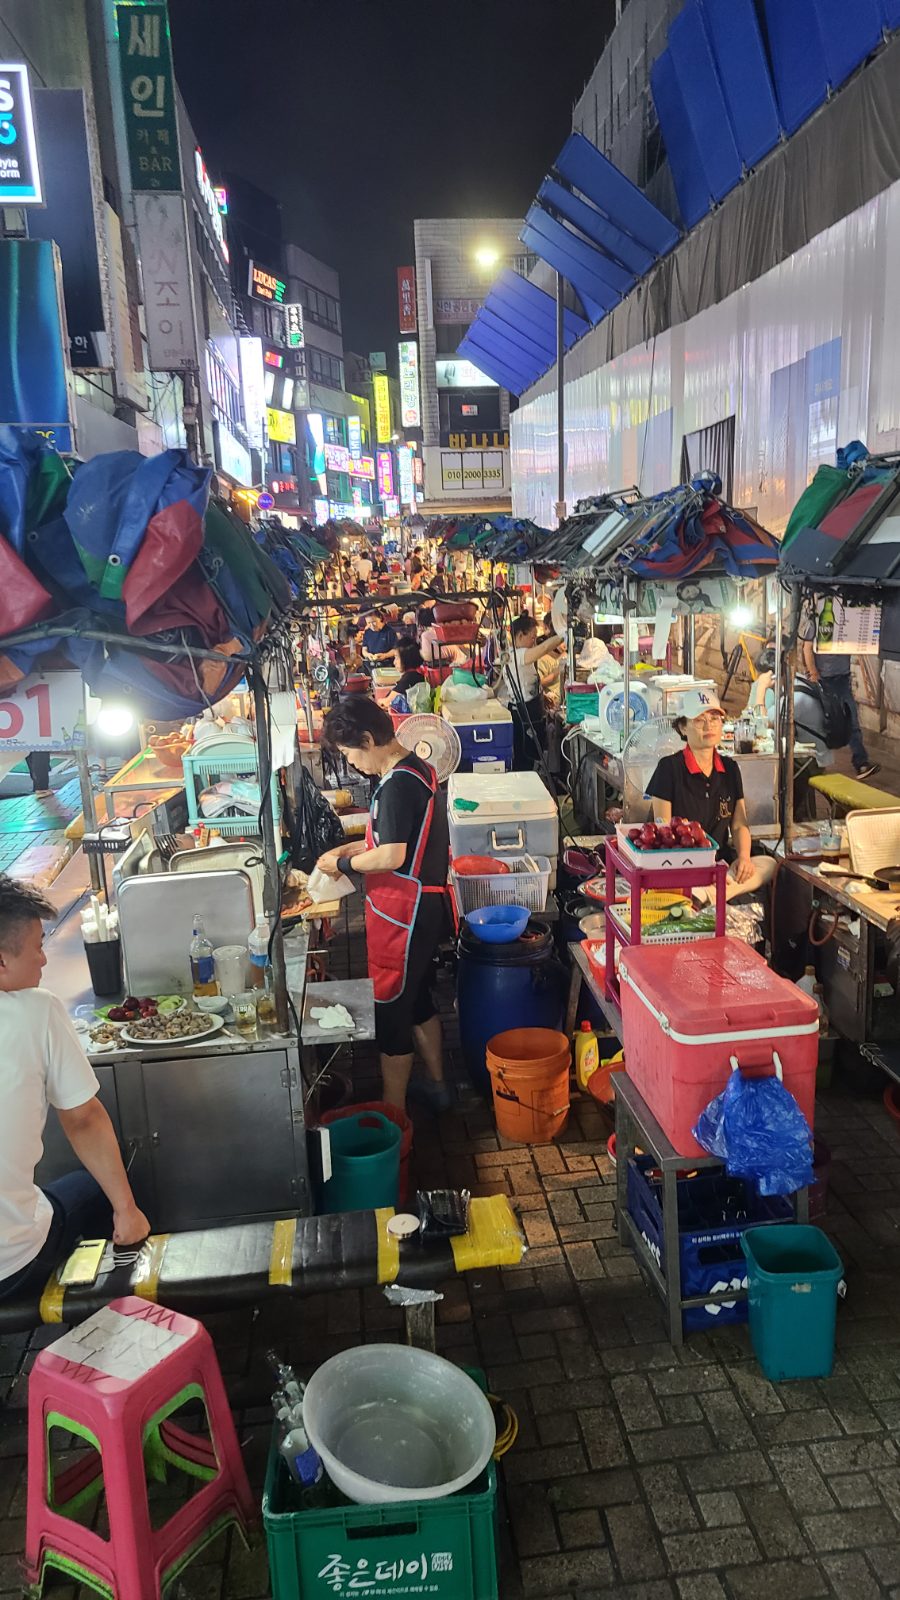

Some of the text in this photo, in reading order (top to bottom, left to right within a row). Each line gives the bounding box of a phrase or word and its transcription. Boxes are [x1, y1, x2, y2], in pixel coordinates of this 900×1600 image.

[127, 14, 165, 118] 세인
[139, 157, 173, 171] BAR
[253, 268, 277, 290] LUCAS
[449, 432, 509, 450] 바나나
[464, 471, 481, 479] 2000
[318, 1553, 427, 1591] 좋은데이
